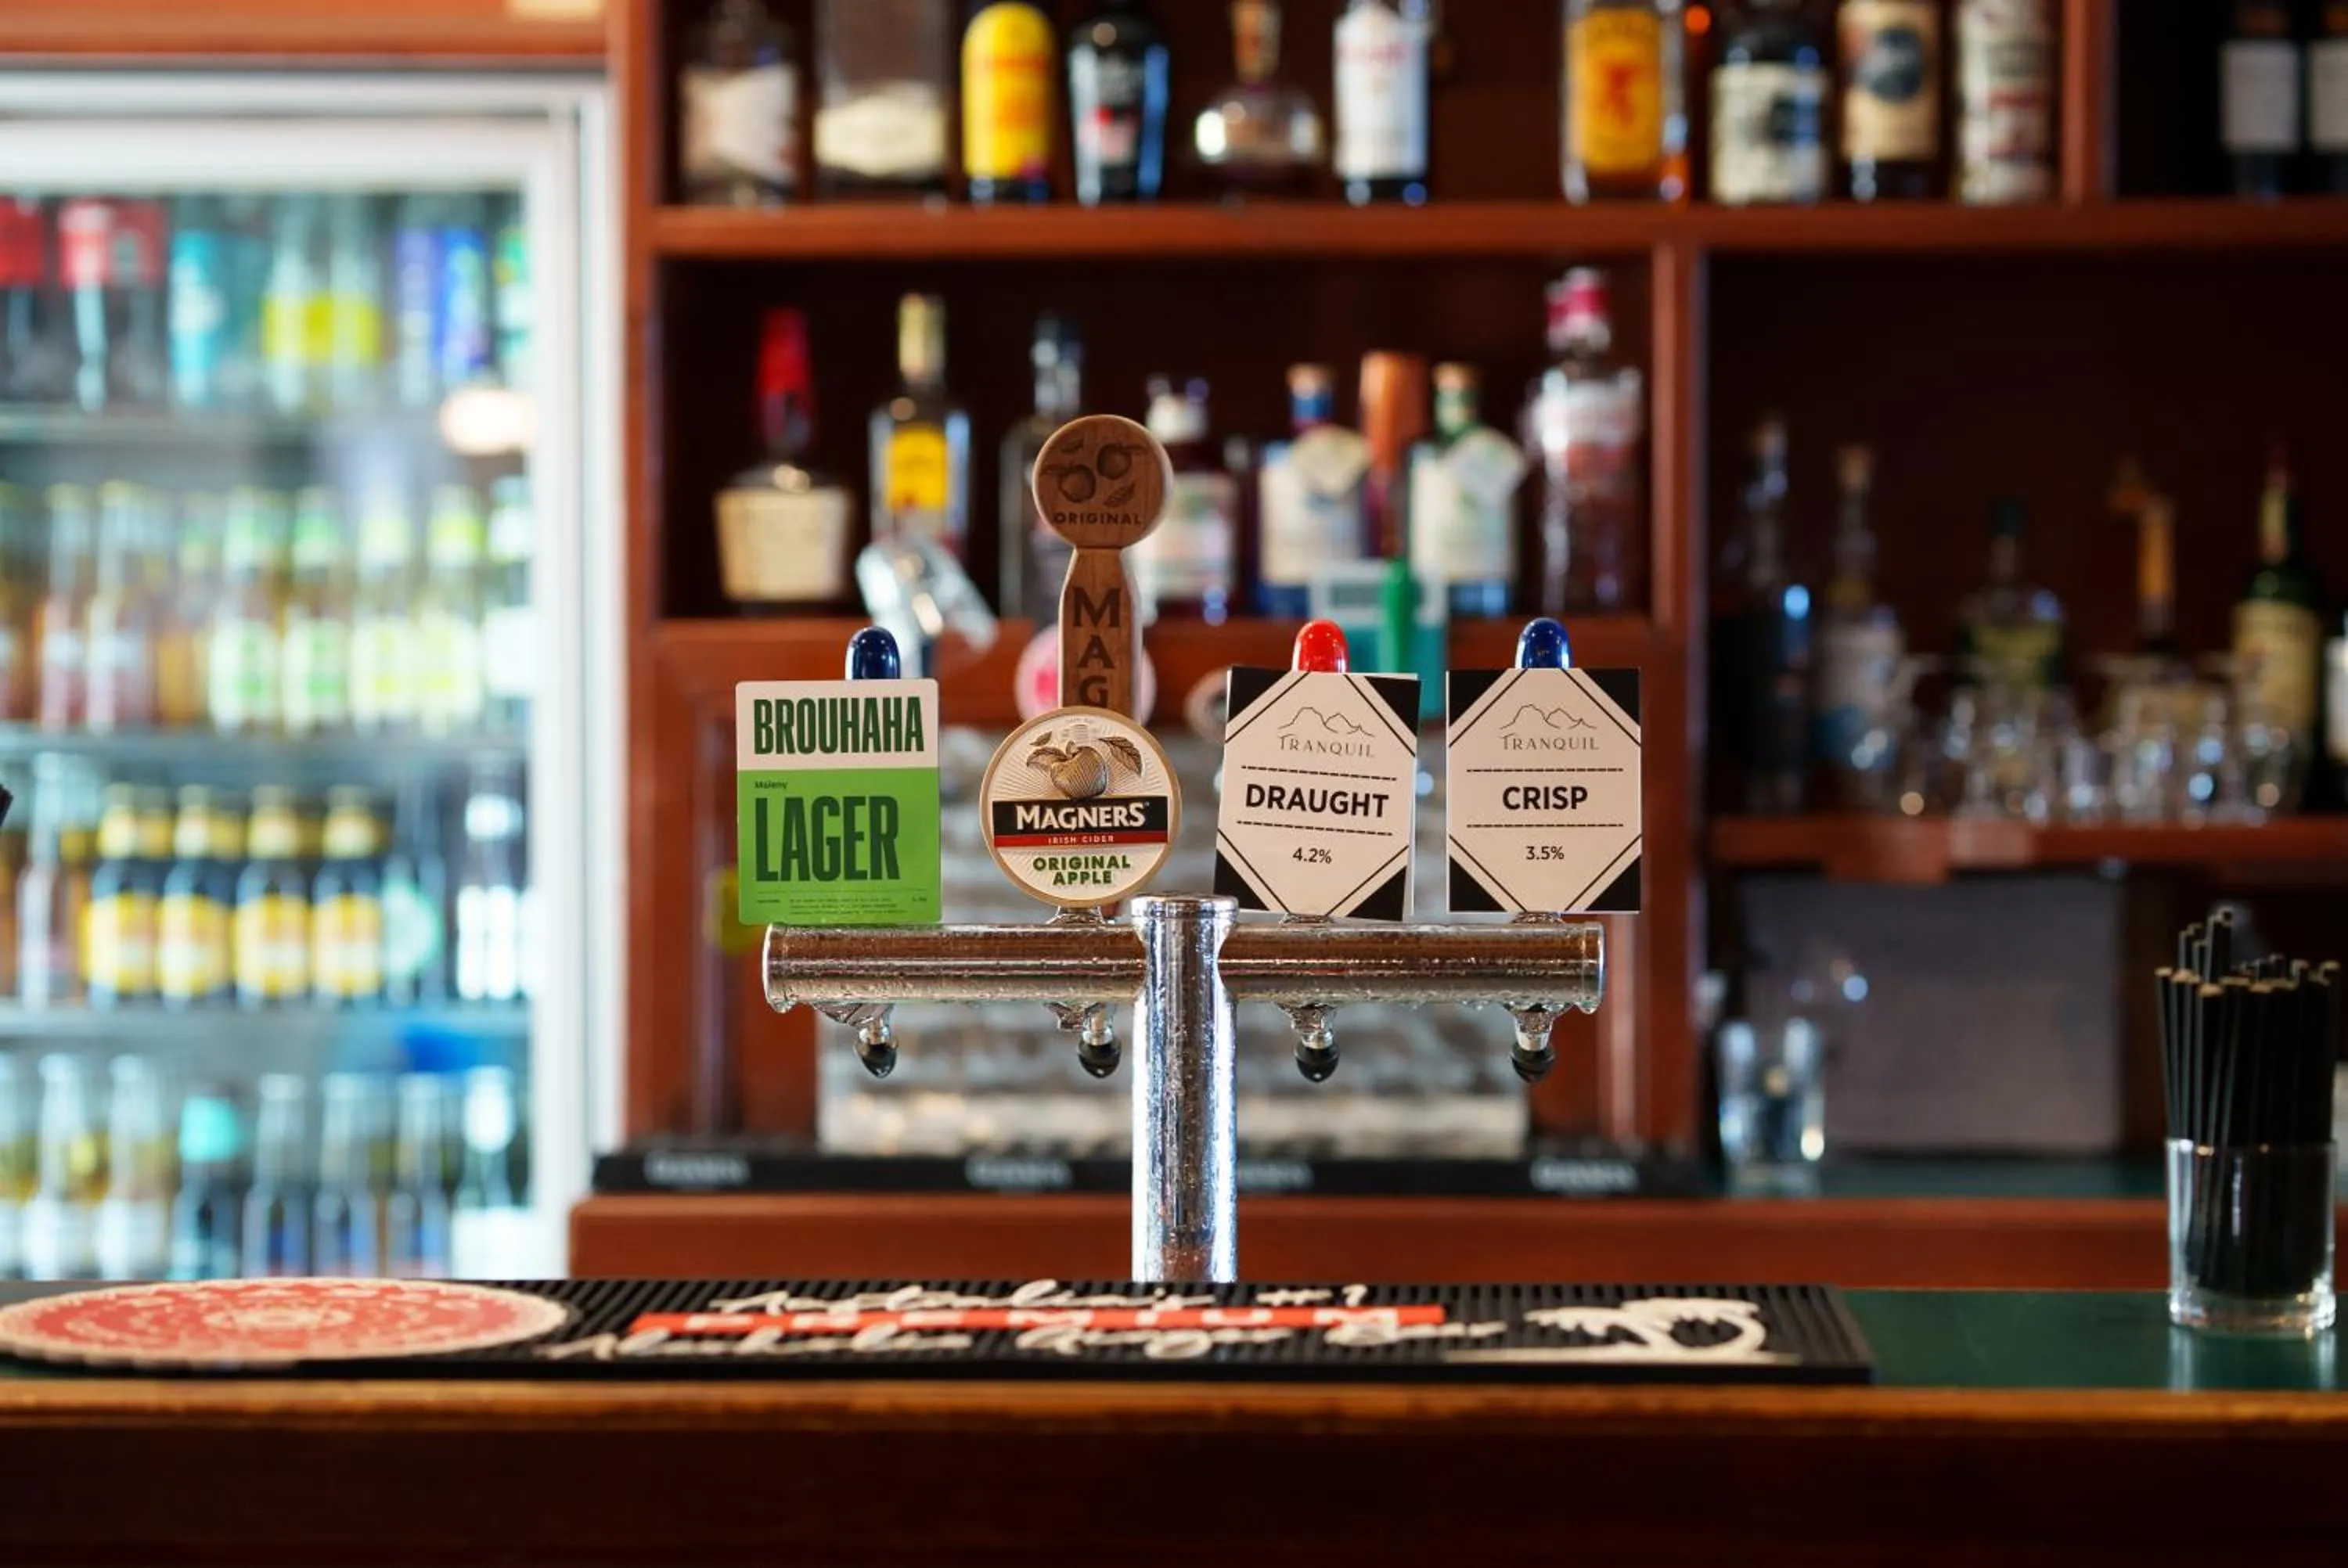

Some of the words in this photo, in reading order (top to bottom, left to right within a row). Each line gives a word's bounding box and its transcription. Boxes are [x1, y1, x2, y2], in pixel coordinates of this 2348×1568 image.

[1053, 512, 1142, 526] ORIGINAL
[753, 696, 924, 754] BROUHAHA
[1276, 733, 1375, 758] TRANQUIL
[1499, 732, 1600, 751] TRANQUIL
[1245, 783, 1389, 818] DRAUGHT
[1503, 786, 1588, 810] CRISP
[1015, 802, 1147, 831] MAGNERS
[754, 796, 901, 882] LAGER
[1082, 835, 1115, 843] CIDER
[1292, 847, 1333, 865] 4.2%
[1525, 845, 1565, 861] 3.5%
[1032, 855, 1131, 871] ORIGINAL
[1053, 871, 1112, 886] APPLE
